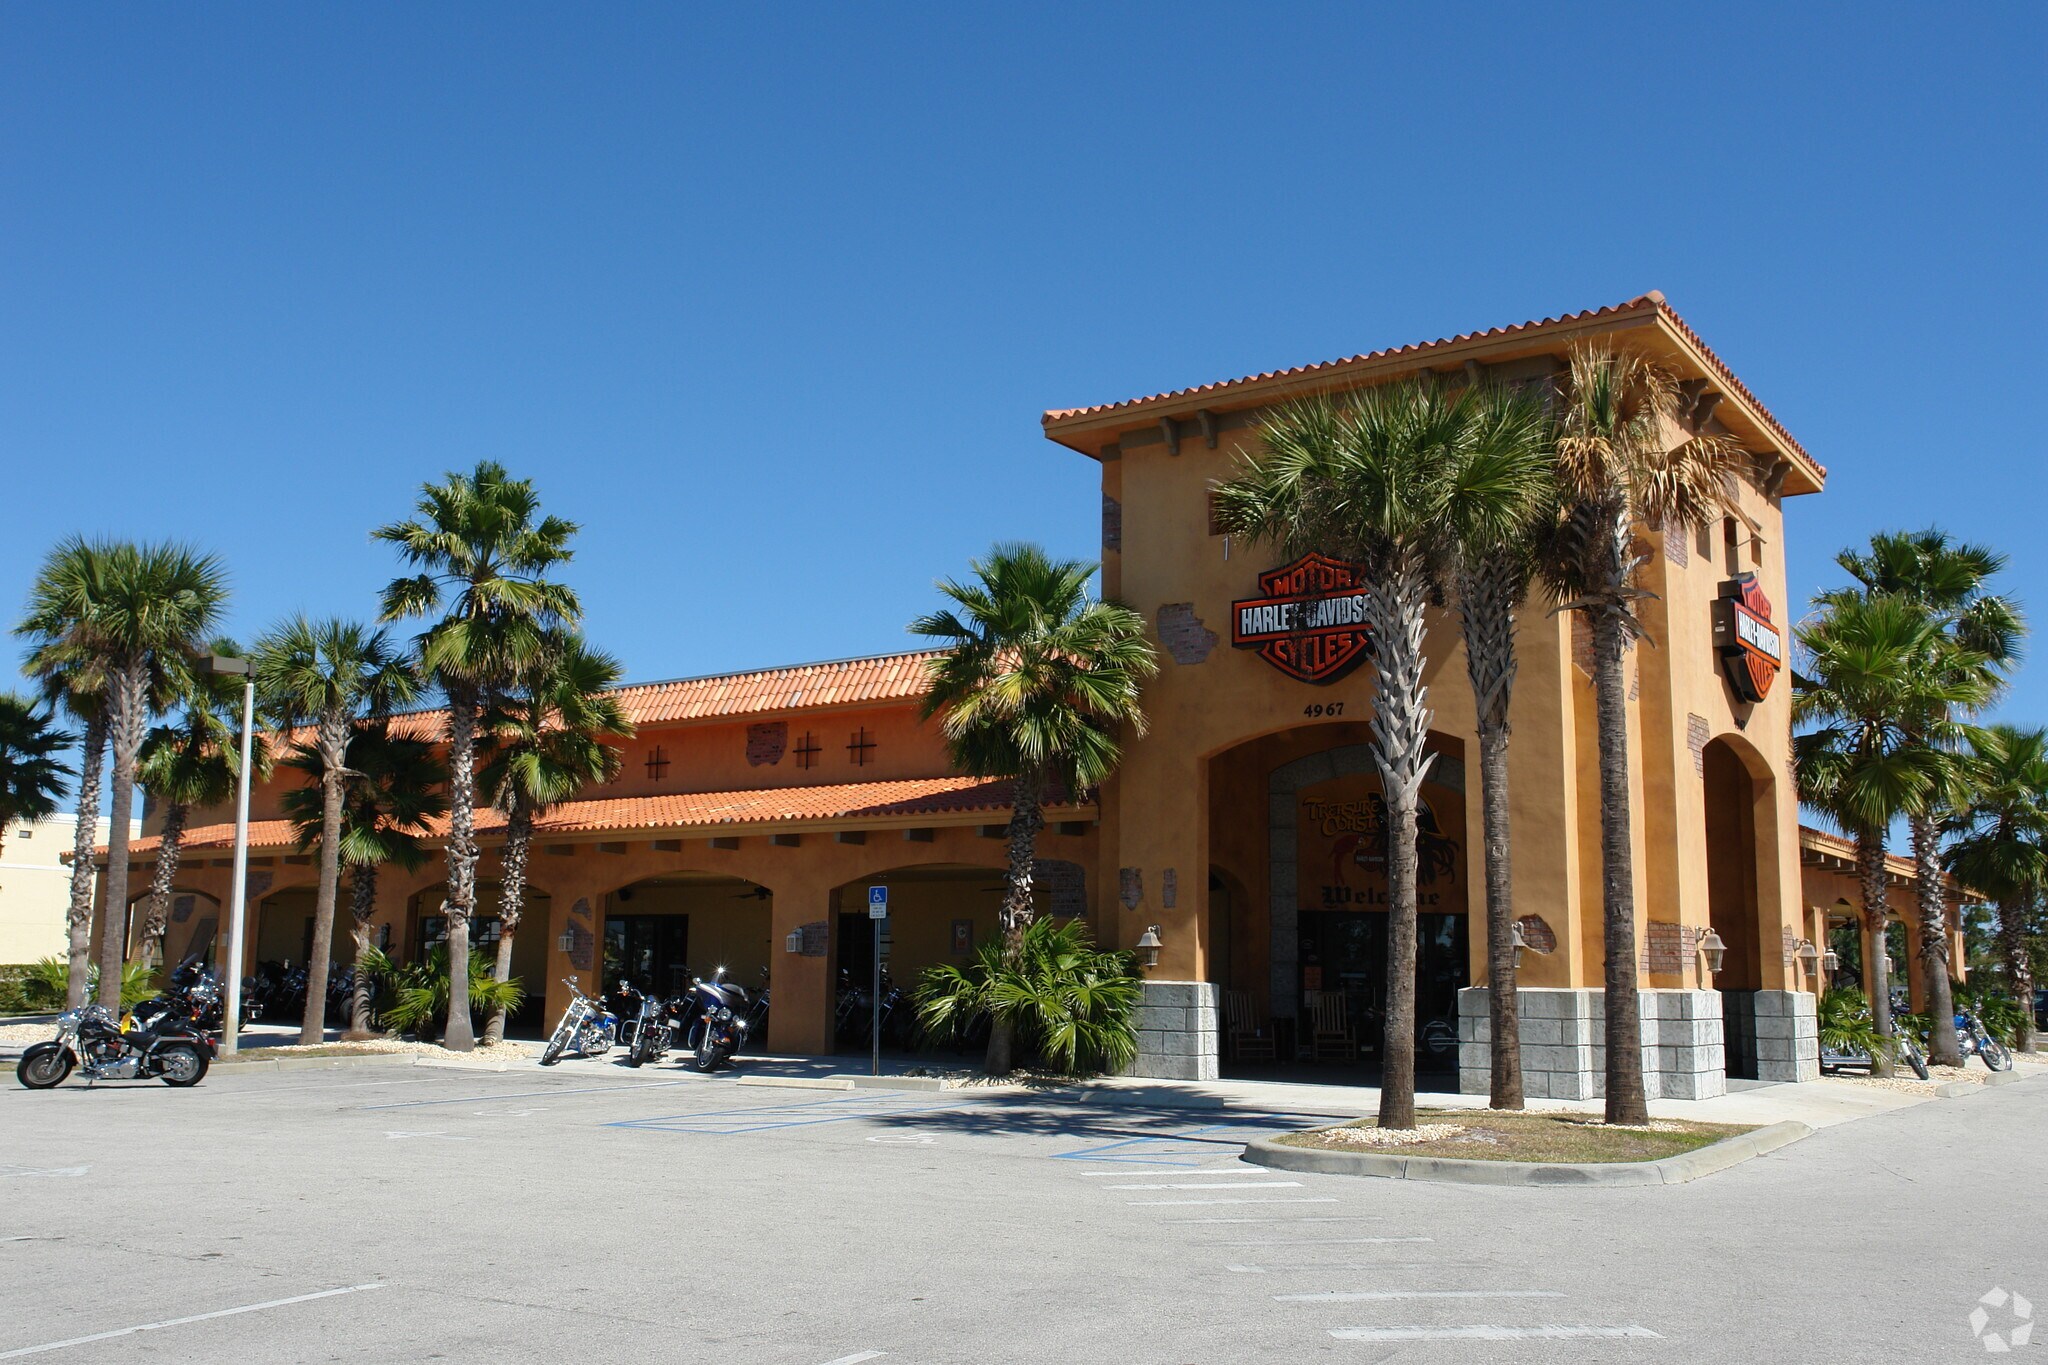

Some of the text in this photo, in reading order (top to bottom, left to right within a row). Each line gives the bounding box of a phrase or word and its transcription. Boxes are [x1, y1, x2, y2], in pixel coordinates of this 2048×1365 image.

[1273, 560, 1351, 596] MOTOR
[1274, 633, 1352, 672] CYCLES
[1303, 702, 1344, 718] 4967
[1322, 886, 1440, 909] Welce
